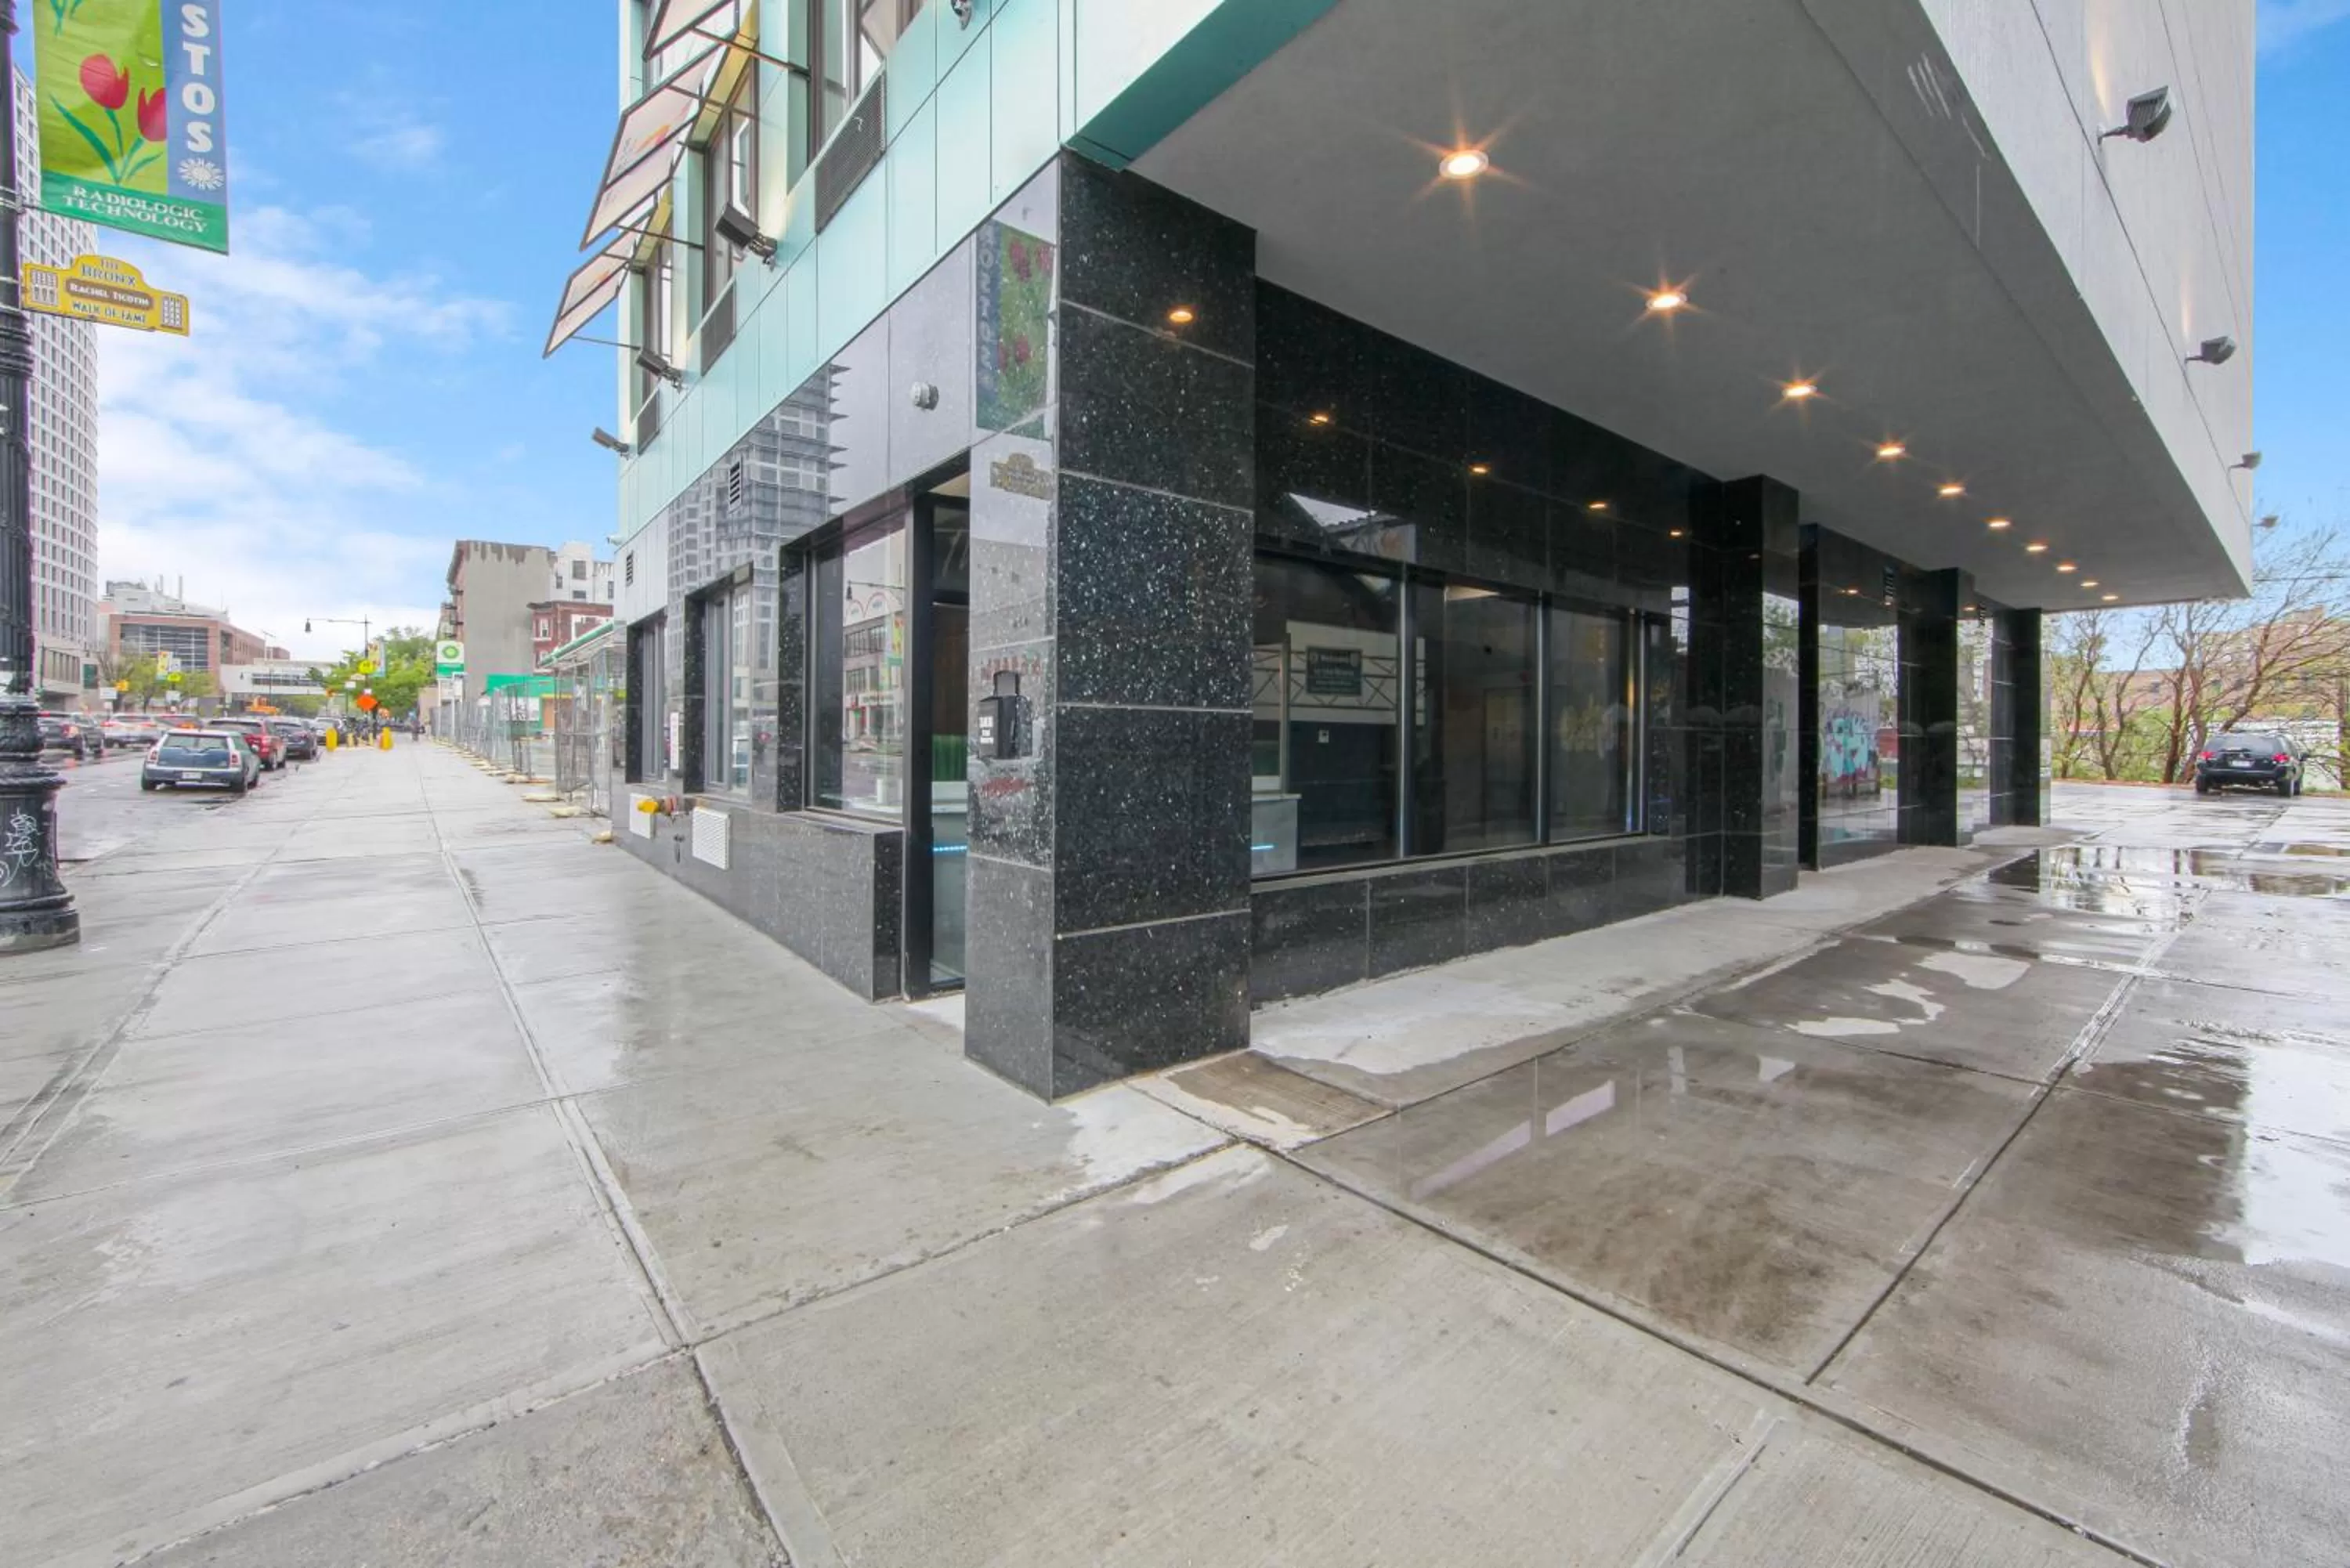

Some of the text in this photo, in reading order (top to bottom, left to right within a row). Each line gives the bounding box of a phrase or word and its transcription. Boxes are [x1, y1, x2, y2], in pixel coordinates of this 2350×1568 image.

[63, 195, 208, 233] TECHNOLOGY
[73, 185, 204, 220] RADIOLOGIC
[81, 264, 136, 286] BRONX
